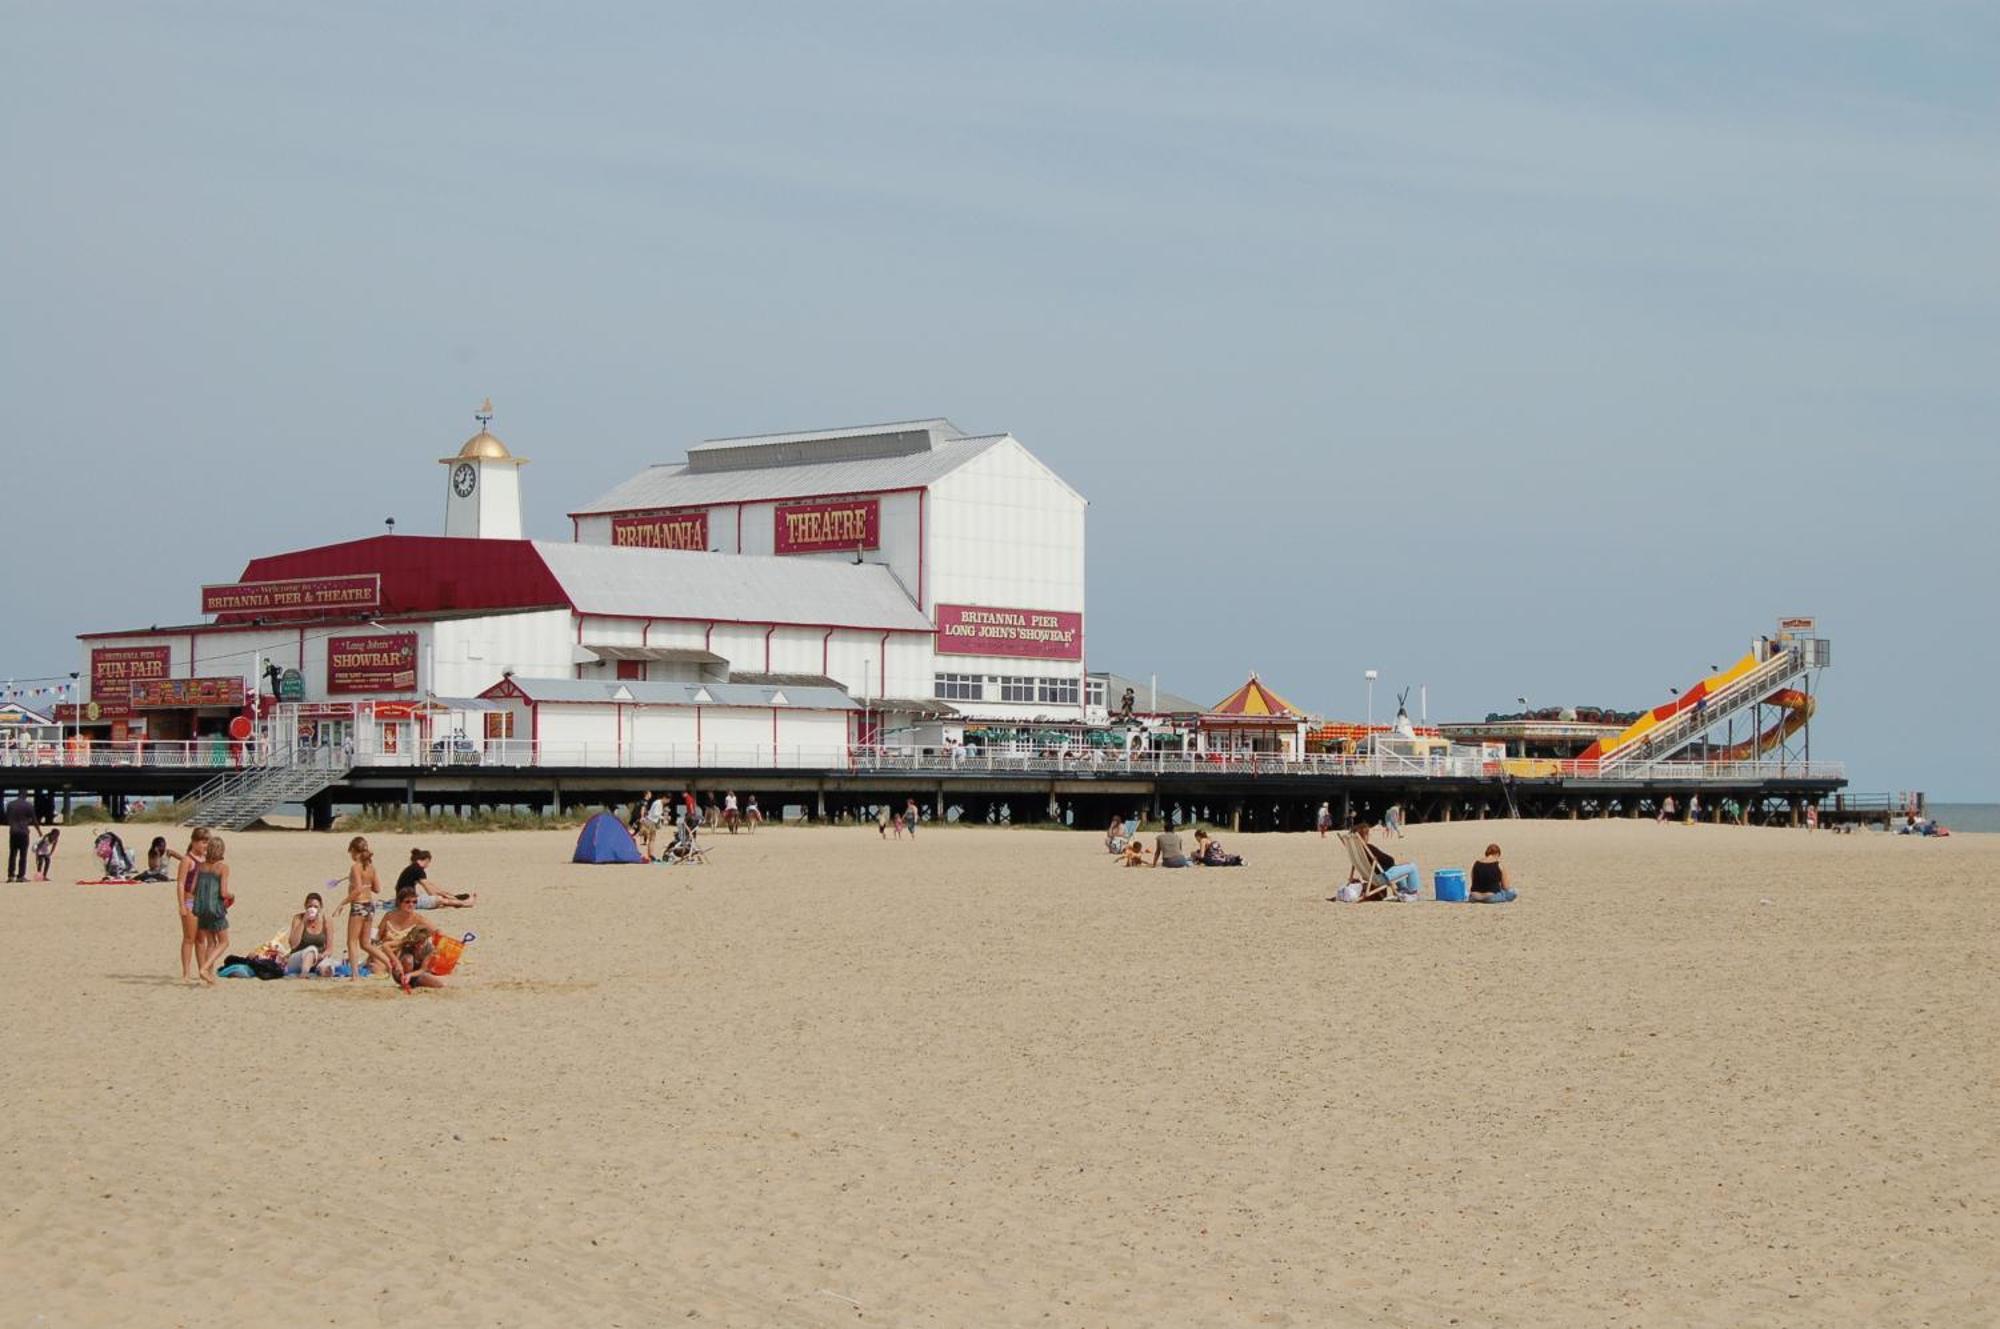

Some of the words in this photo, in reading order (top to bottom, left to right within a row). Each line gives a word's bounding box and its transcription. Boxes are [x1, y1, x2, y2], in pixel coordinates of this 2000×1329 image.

[616, 519, 705, 550] BRITANNIA
[786, 509, 867, 544] THEATRE
[208, 594, 270, 609] BRITANNIA
[274, 592, 301, 605] PIER
[304, 593, 313, 602] &
[316, 588, 372, 602] THEATRE
[960, 611, 1026, 626] BRITANNIA
[1031, 615, 1058, 628] PIER
[945, 624, 976, 637] LONG
[96, 662, 126, 678] FUN
[130, 660, 163, 677] FAIR
[333, 652, 401, 668] SHOWBAR
